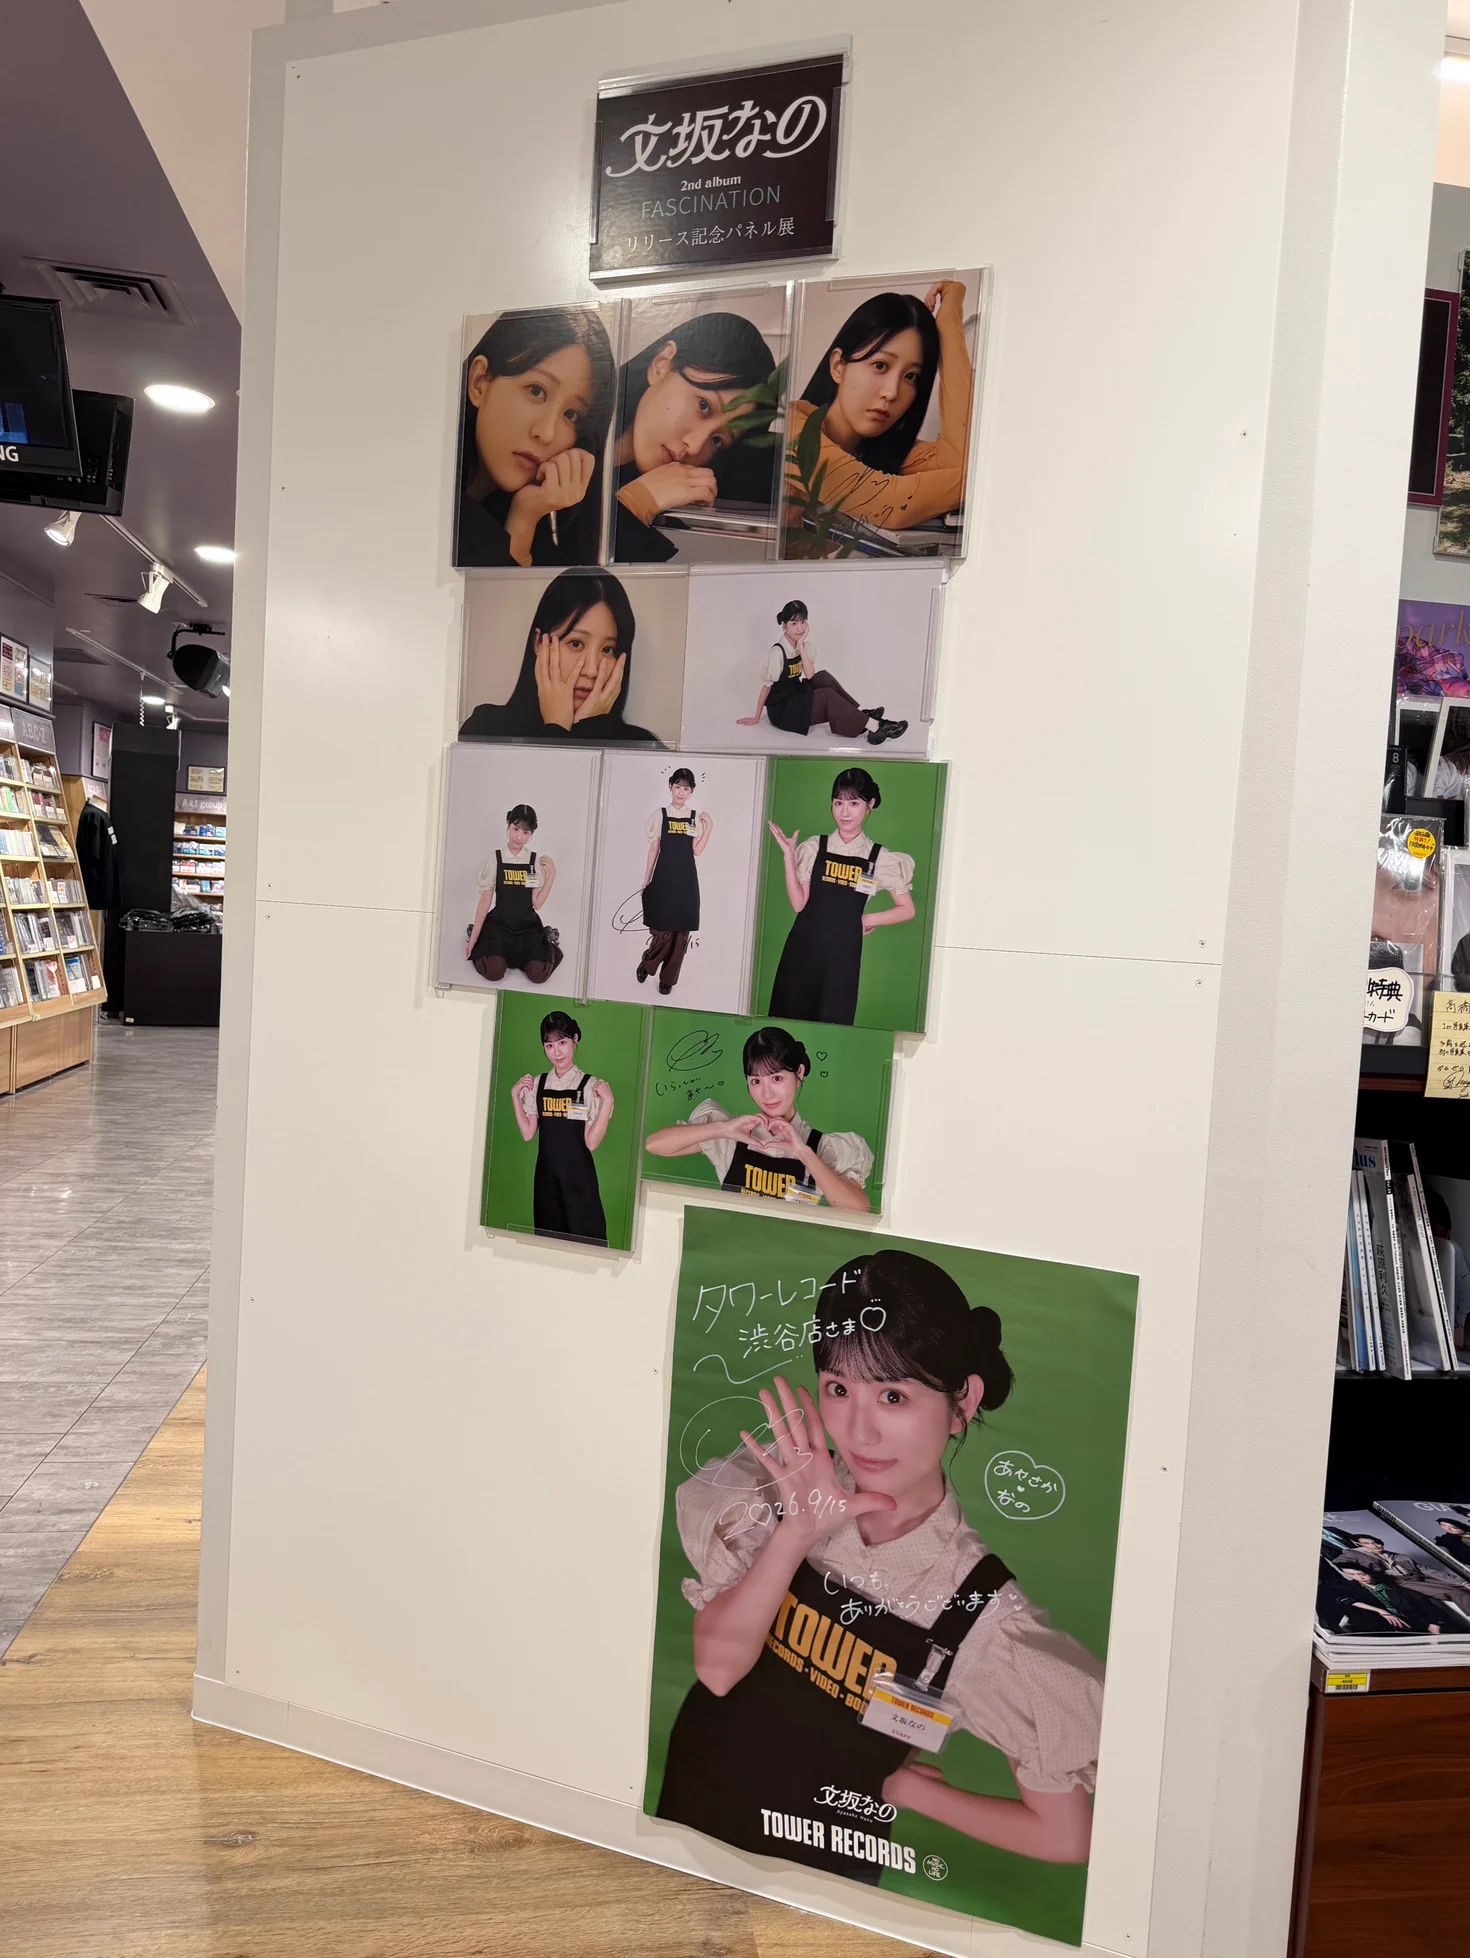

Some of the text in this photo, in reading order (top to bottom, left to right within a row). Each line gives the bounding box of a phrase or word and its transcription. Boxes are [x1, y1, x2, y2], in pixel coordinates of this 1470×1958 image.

[605, 95, 827, 178] 文坂なの
[680, 175, 741, 192] 2nd album
[641, 185, 781, 219] FASCINATION
[627, 216, 795, 253] リリース記念パネル展
[825, 859, 863, 882] TOWER
[745, 1164, 797, 1199] TOWER
[692, 1268, 863, 1333] タワーレコード
[738, 1314, 857, 1360] 渋谷店さま
[993, 1460, 1058, 1493] あやさか
[997, 1489, 1031, 1513] なの
[839, 1590, 1003, 1626] ありがとうございます
[774, 1590, 898, 1699] TOWER
[809, 1666, 840, 1699] VIDEO
[813, 1784, 897, 1823] 文坂なの
[760, 1808, 917, 1874] TOWER RECORDS
